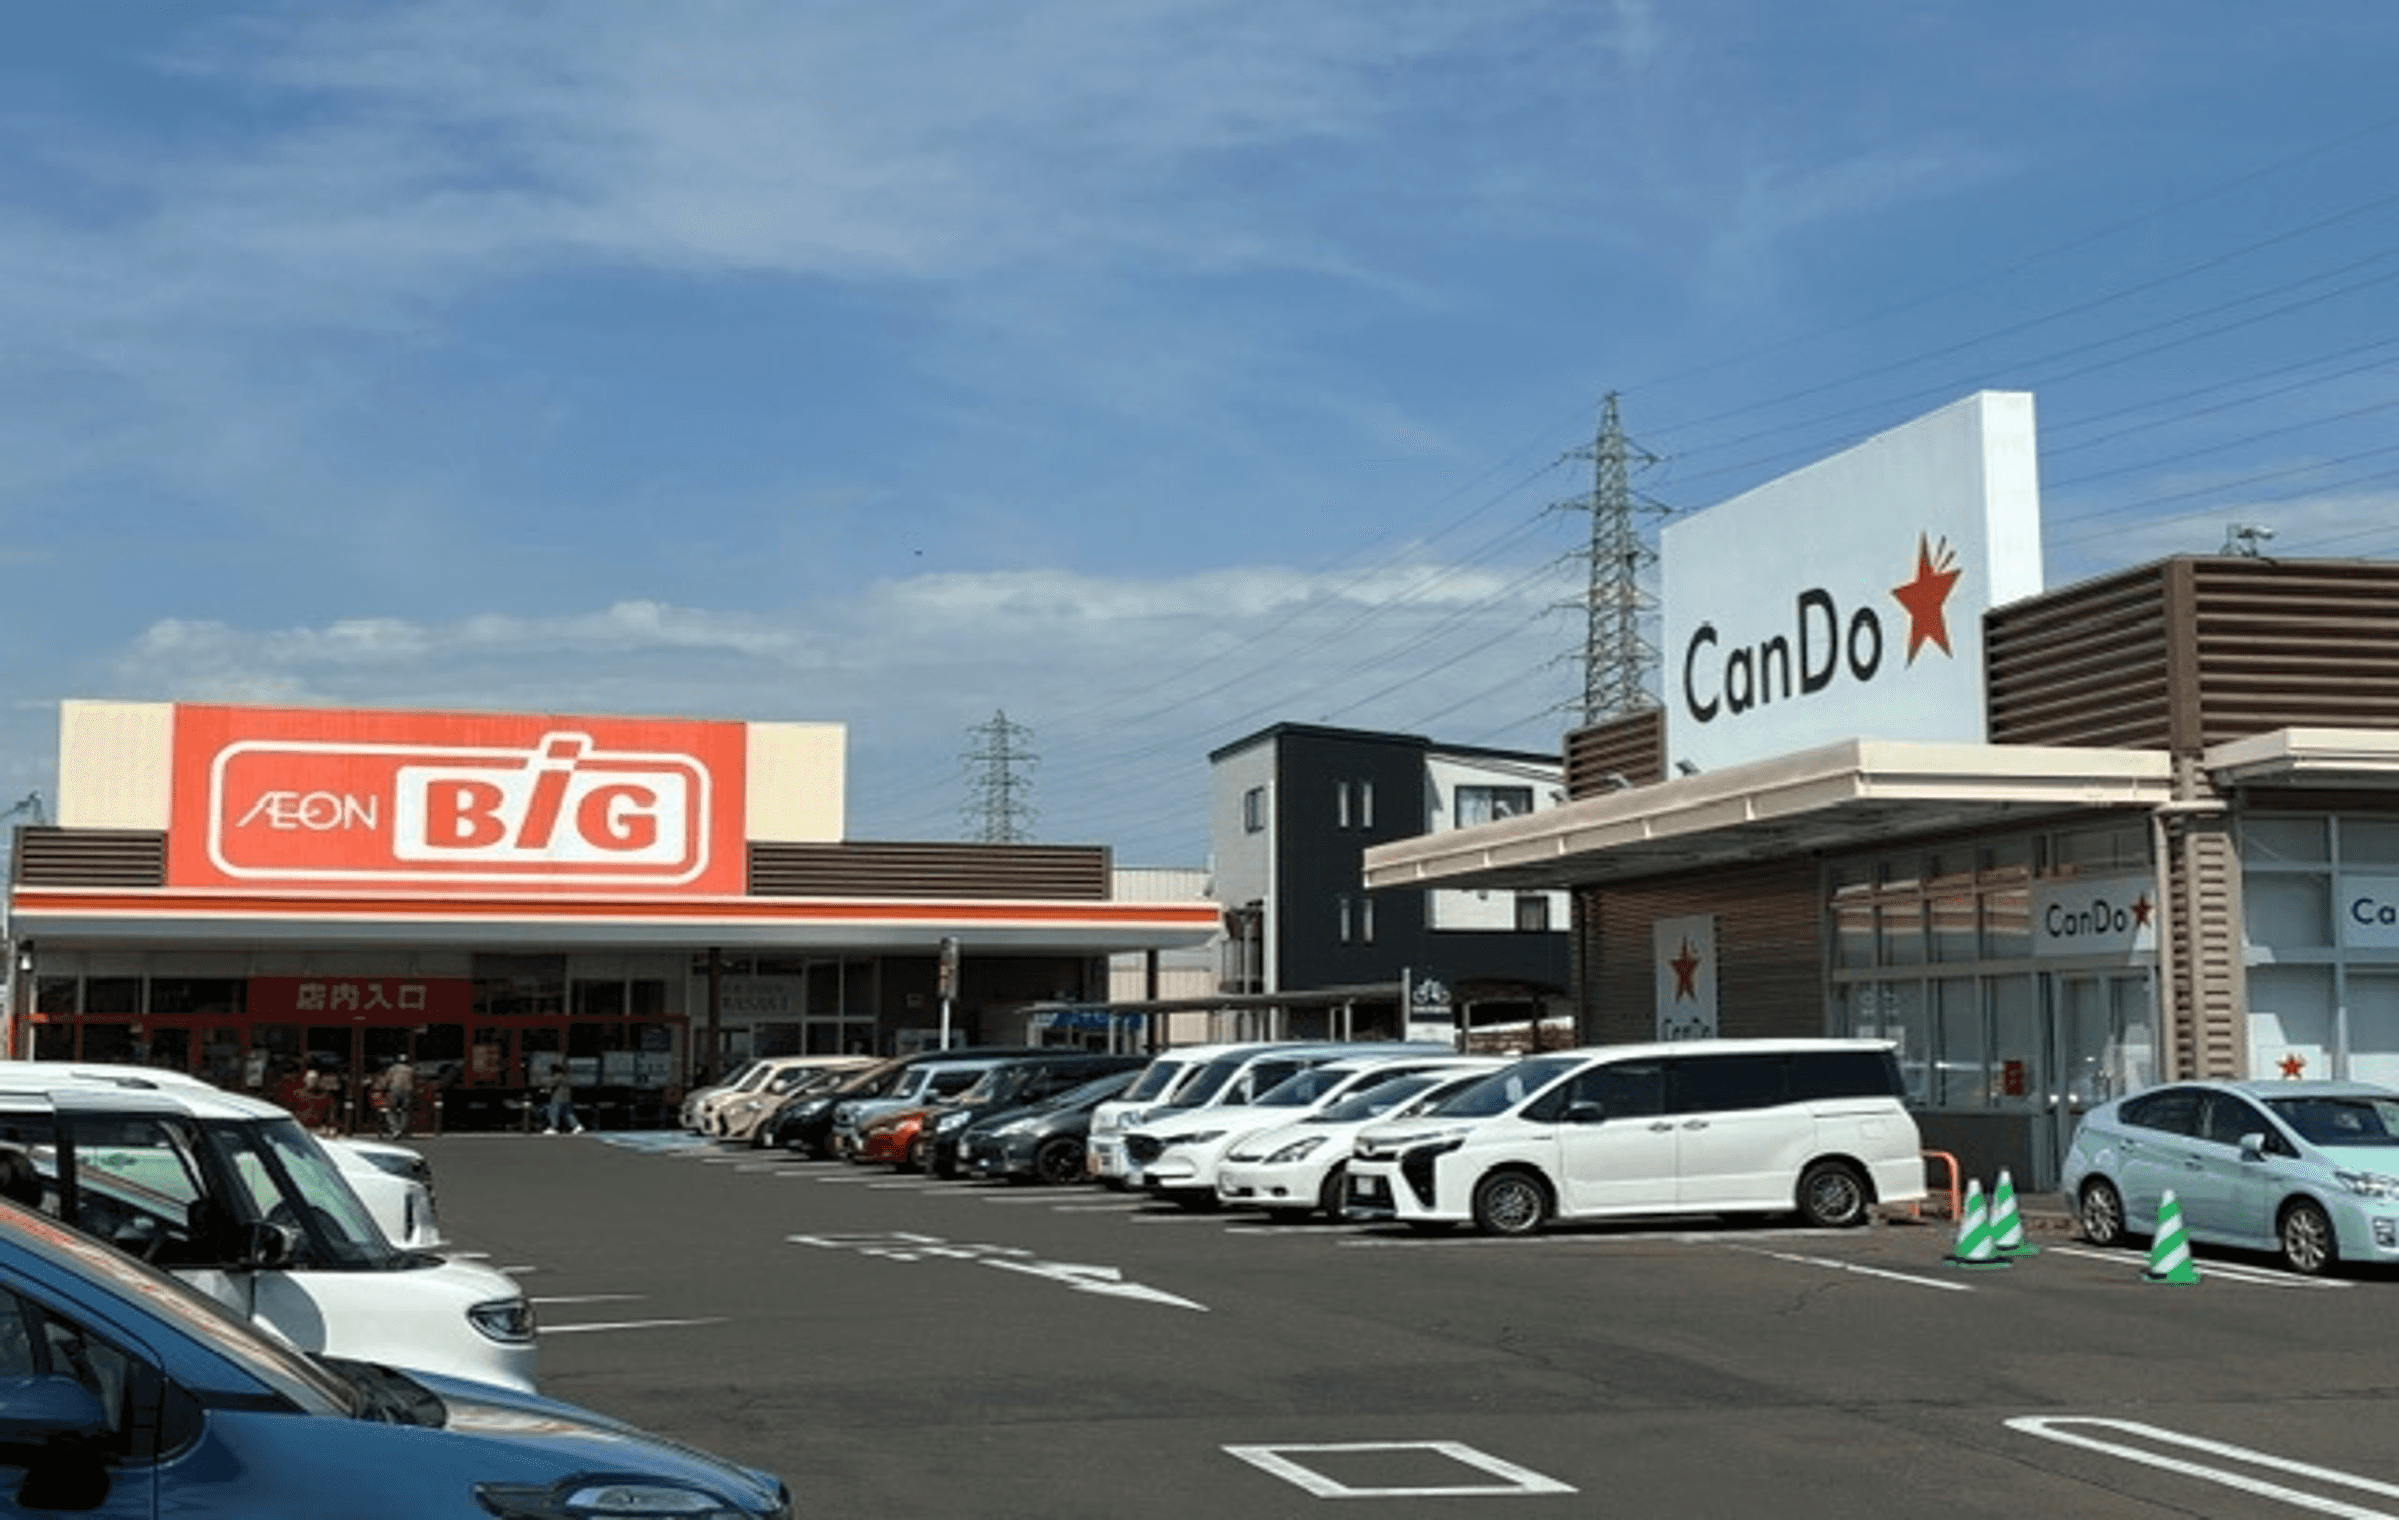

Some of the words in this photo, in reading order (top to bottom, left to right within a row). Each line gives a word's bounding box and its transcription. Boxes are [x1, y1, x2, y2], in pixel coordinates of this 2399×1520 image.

[1684, 582, 1882, 723] CanDo
[2046, 899, 2127, 938] CanDo
[296, 983, 427, 1011] 店内入口
